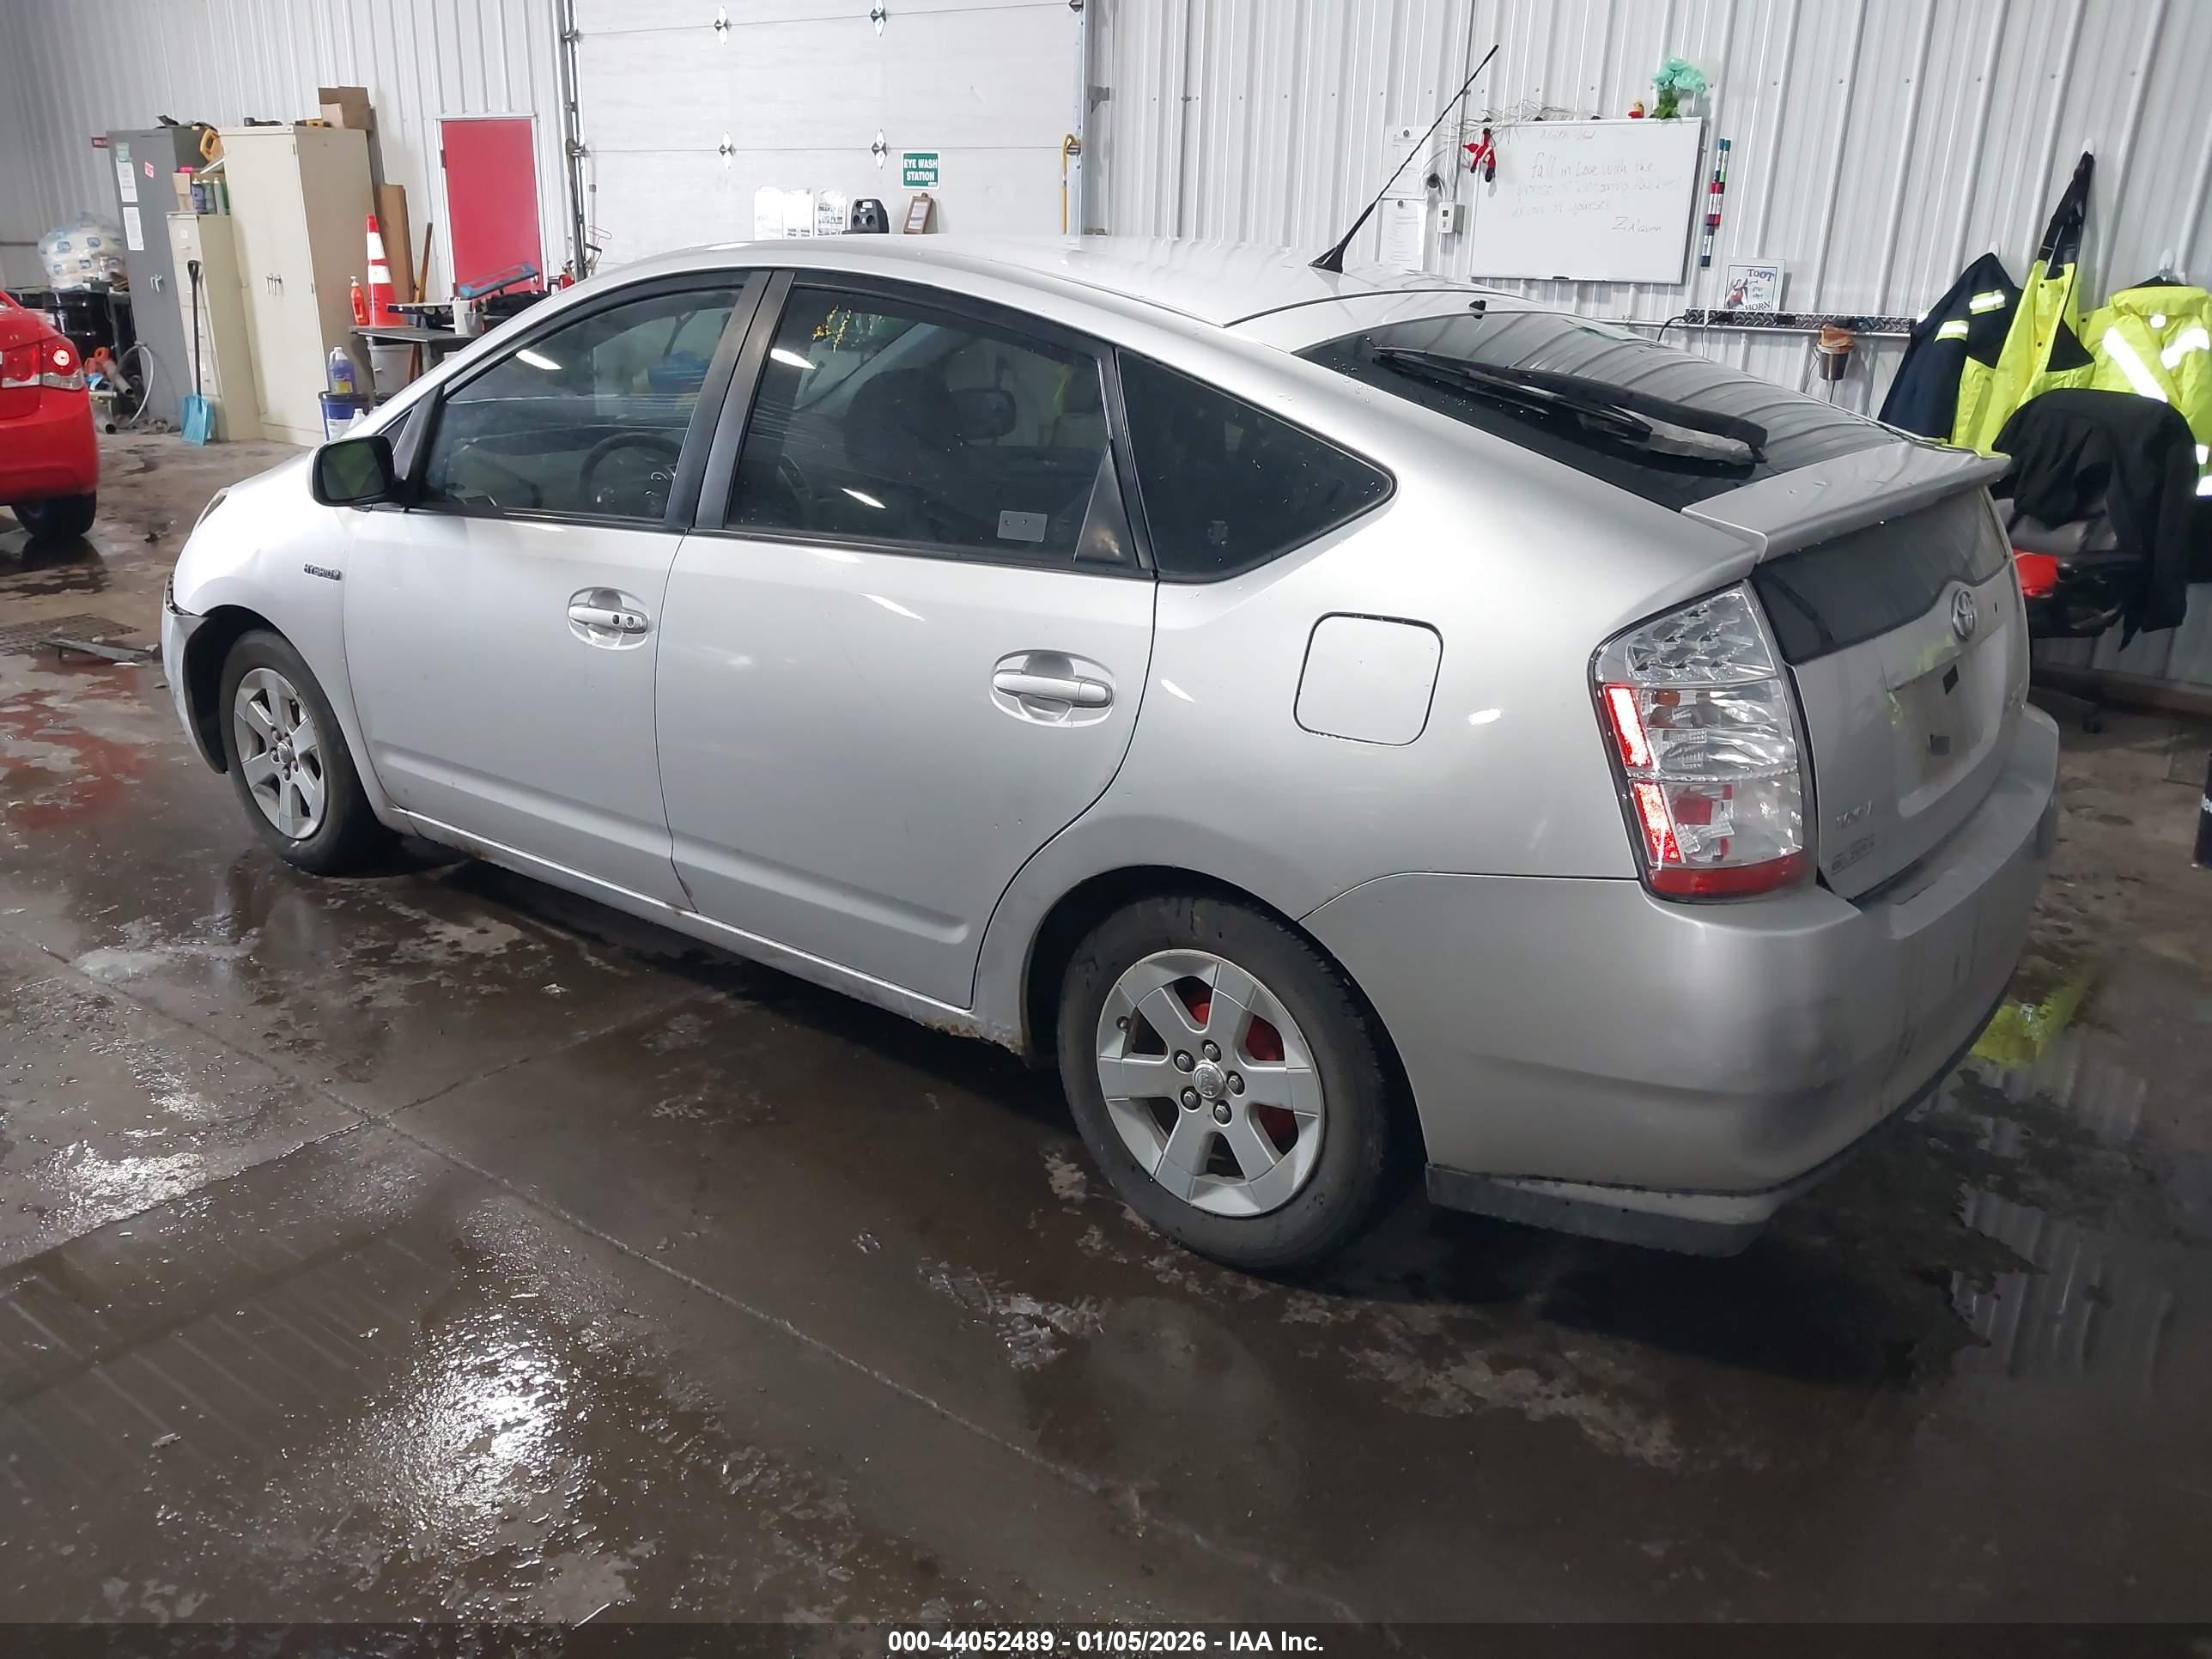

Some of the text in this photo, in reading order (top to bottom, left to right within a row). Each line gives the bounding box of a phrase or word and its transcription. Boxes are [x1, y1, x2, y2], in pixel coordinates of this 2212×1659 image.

[903, 158, 938, 169] EYE WASH
[906, 170, 935, 181] STATION
[1747, 268, 1775, 282] TOOT
